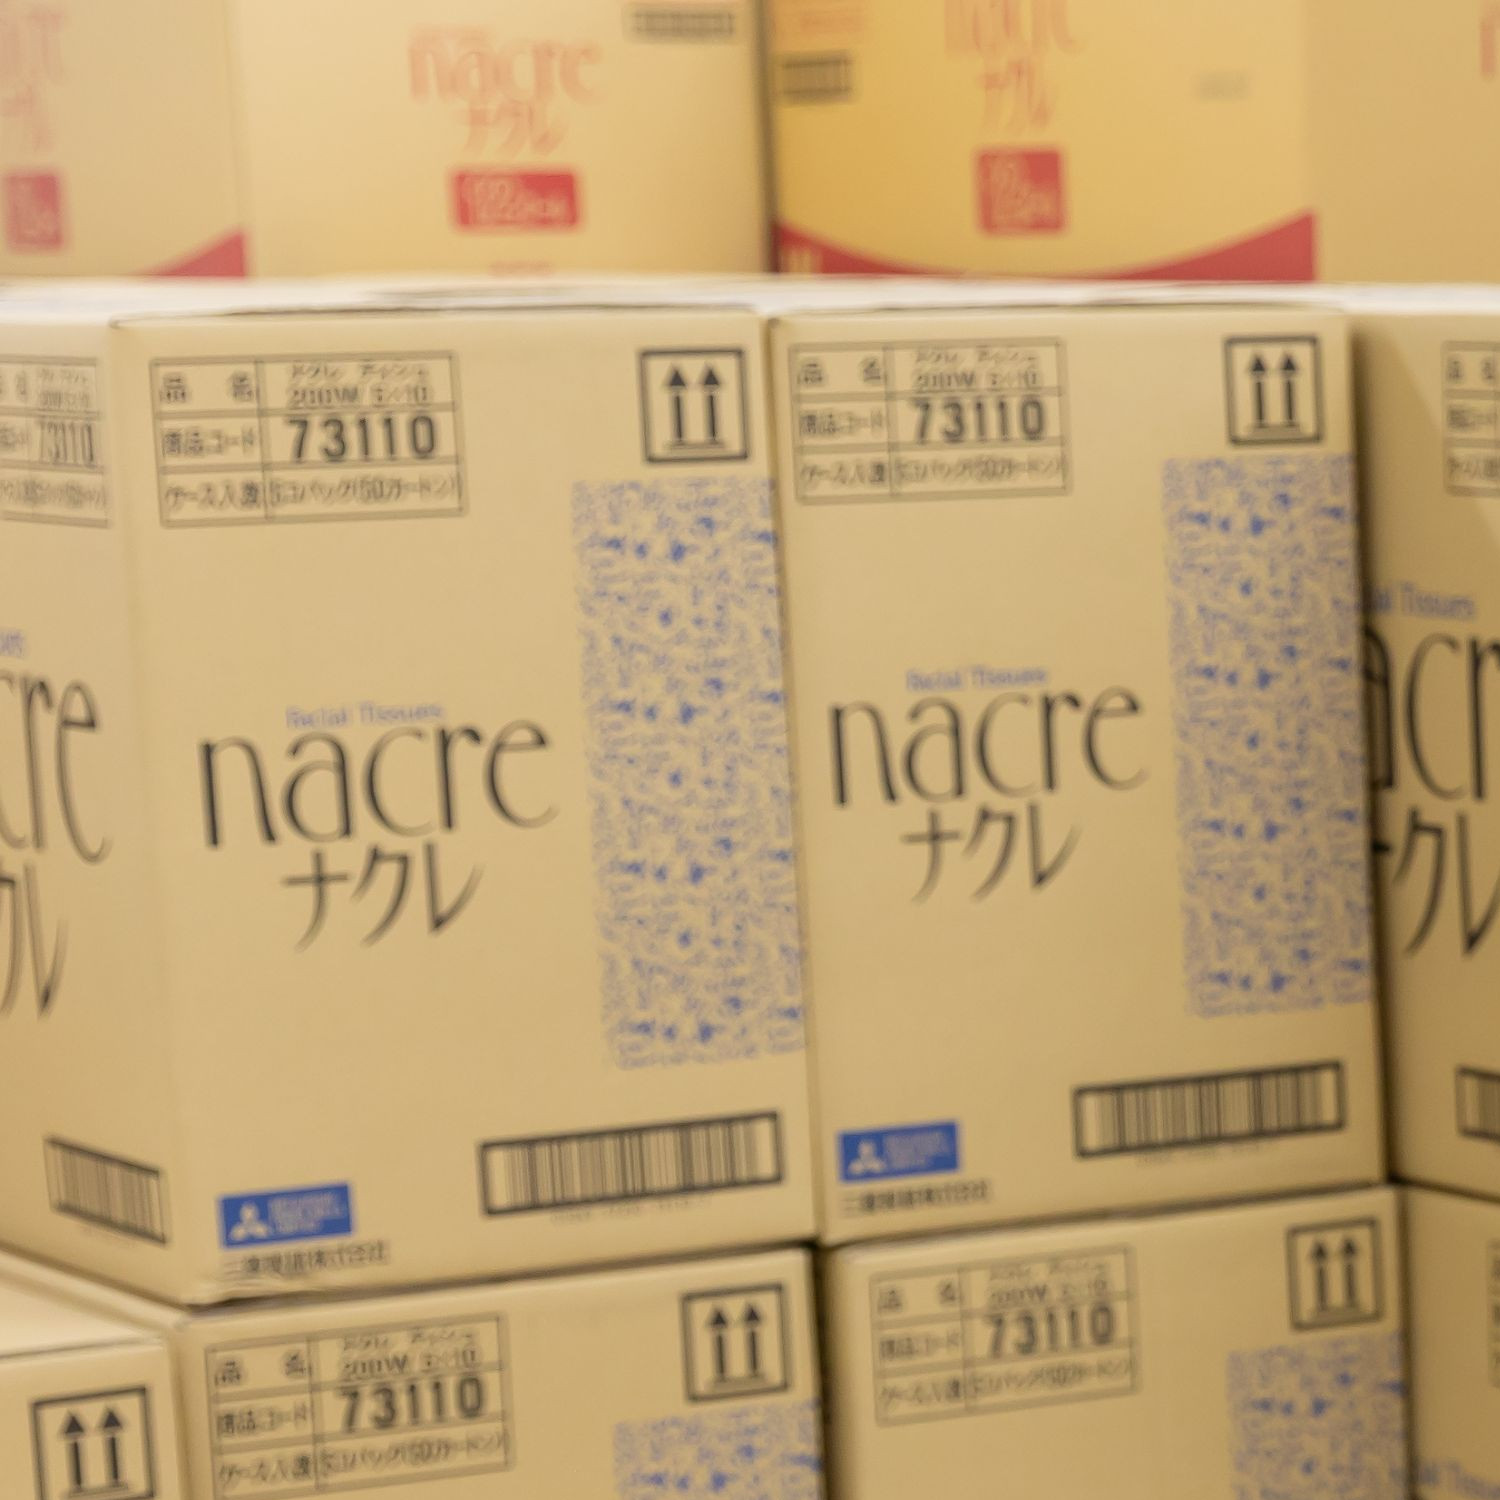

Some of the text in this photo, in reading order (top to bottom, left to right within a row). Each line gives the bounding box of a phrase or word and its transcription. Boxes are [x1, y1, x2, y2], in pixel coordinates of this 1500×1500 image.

[286, 414, 437, 464] 73110
[908, 396, 1046, 446] 73110
[198, 718, 560, 849] nacre
[827, 686, 1151, 808] nacre
[900, 802, 1084, 906] ナクレ
[280, 841, 486, 952] ナクレ
[985, 1300, 1116, 1359] 73110
[336, 1376, 485, 1434] 73110
